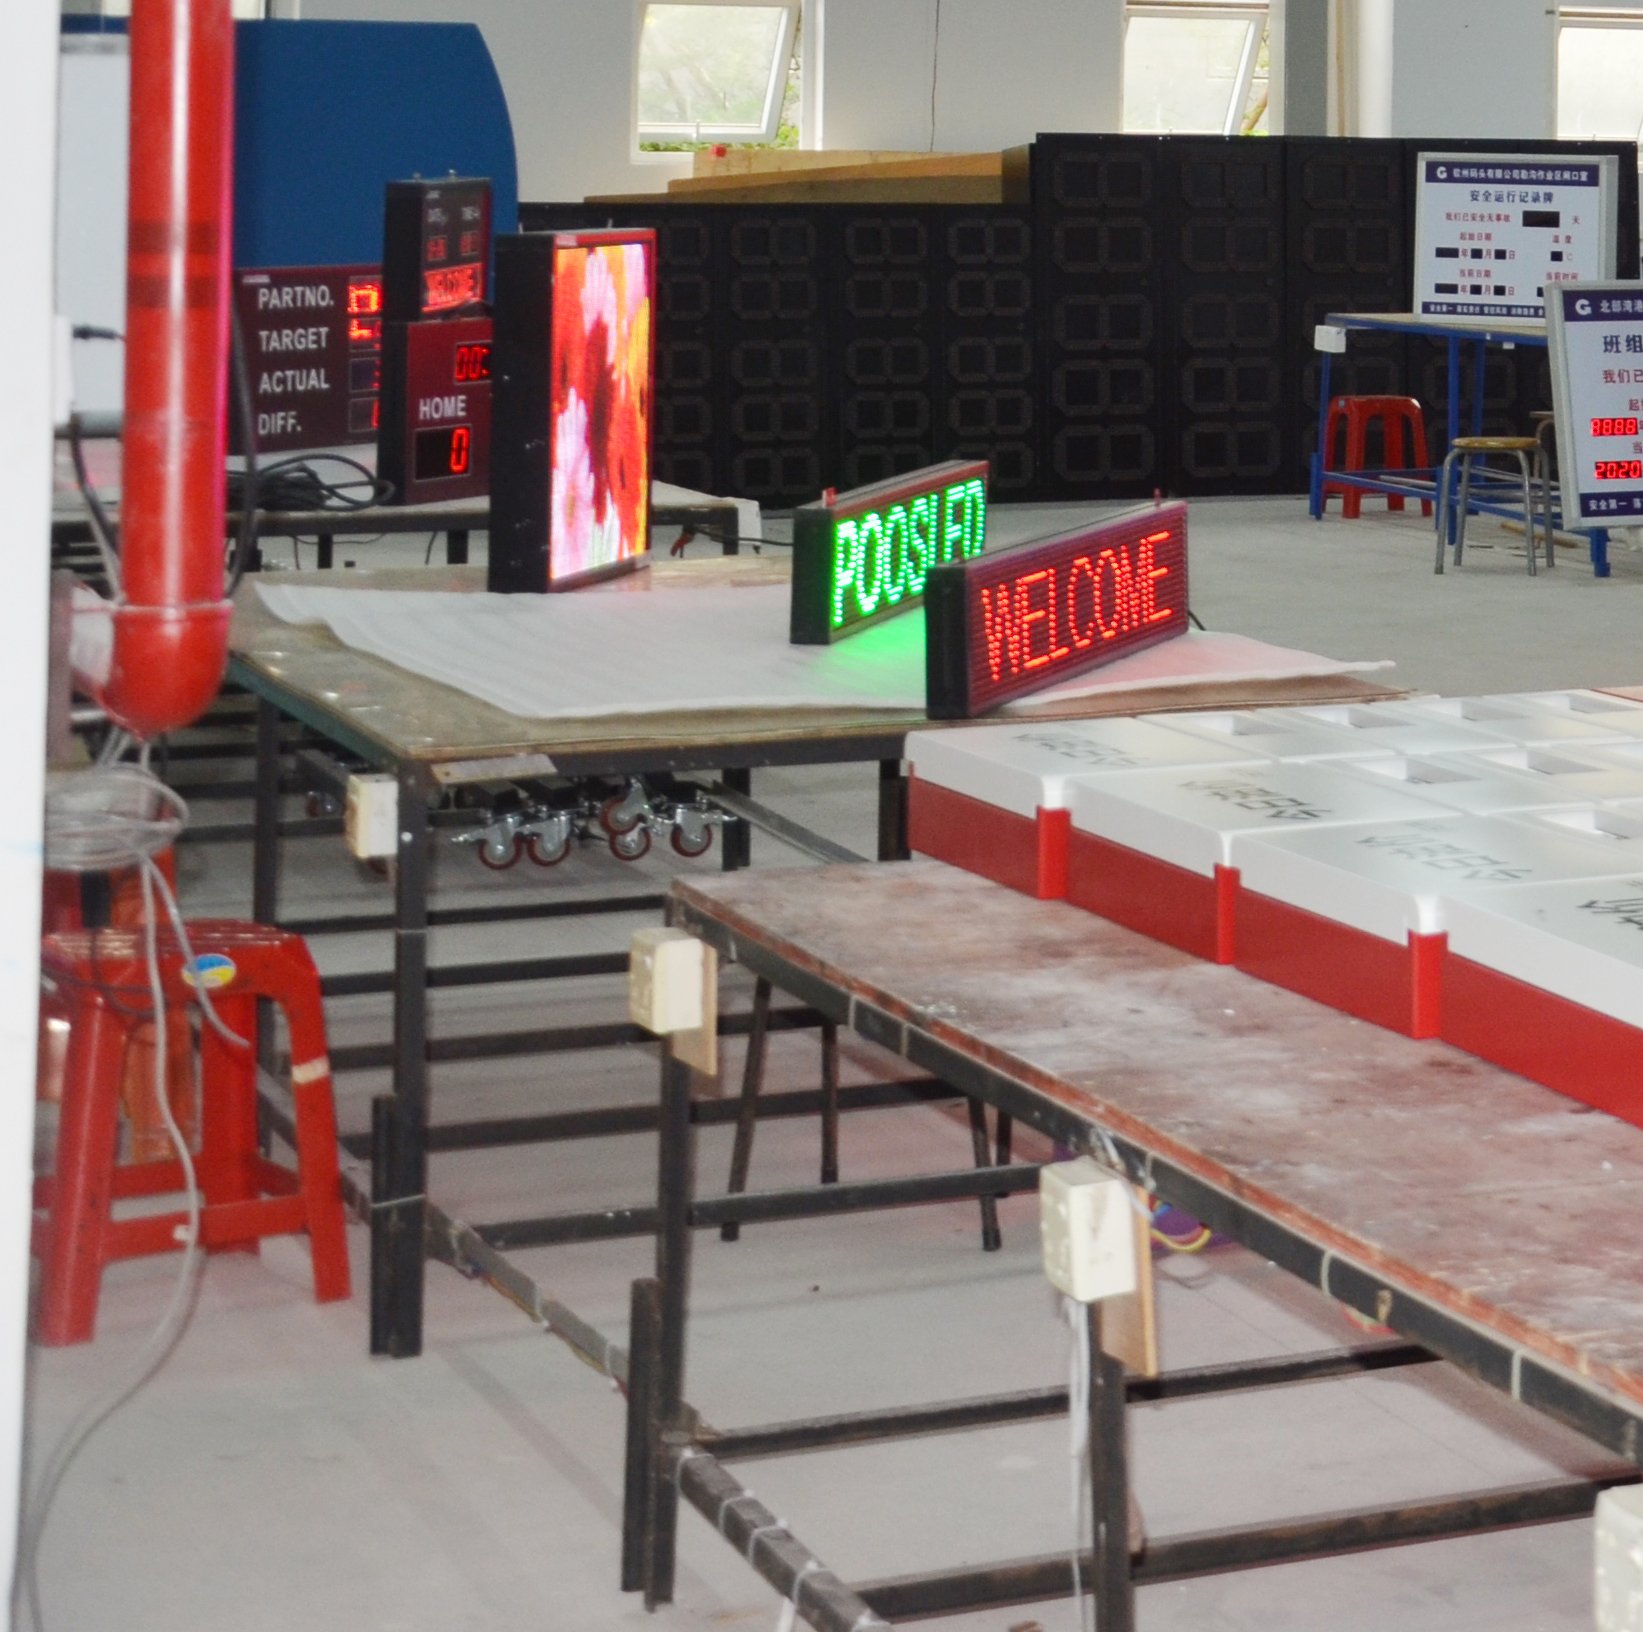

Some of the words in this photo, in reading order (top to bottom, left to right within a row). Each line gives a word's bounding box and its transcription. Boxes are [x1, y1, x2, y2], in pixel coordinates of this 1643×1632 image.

[1470, 189, 1554, 203] 安全运行记录牌
[1460, 232, 1492, 241] 起始日期
[258, 285, 334, 309] PARTNO.
[259, 327, 329, 352] TARGET
[259, 370, 330, 393] ACTUAL
[419, 395, 467, 418] HOME
[258, 411, 302, 435] DIFF.
[449, 427, 470, 474] 0
[1589, 500, 1628, 510] 安全第一
[981, 530, 1173, 680] WELCOME
